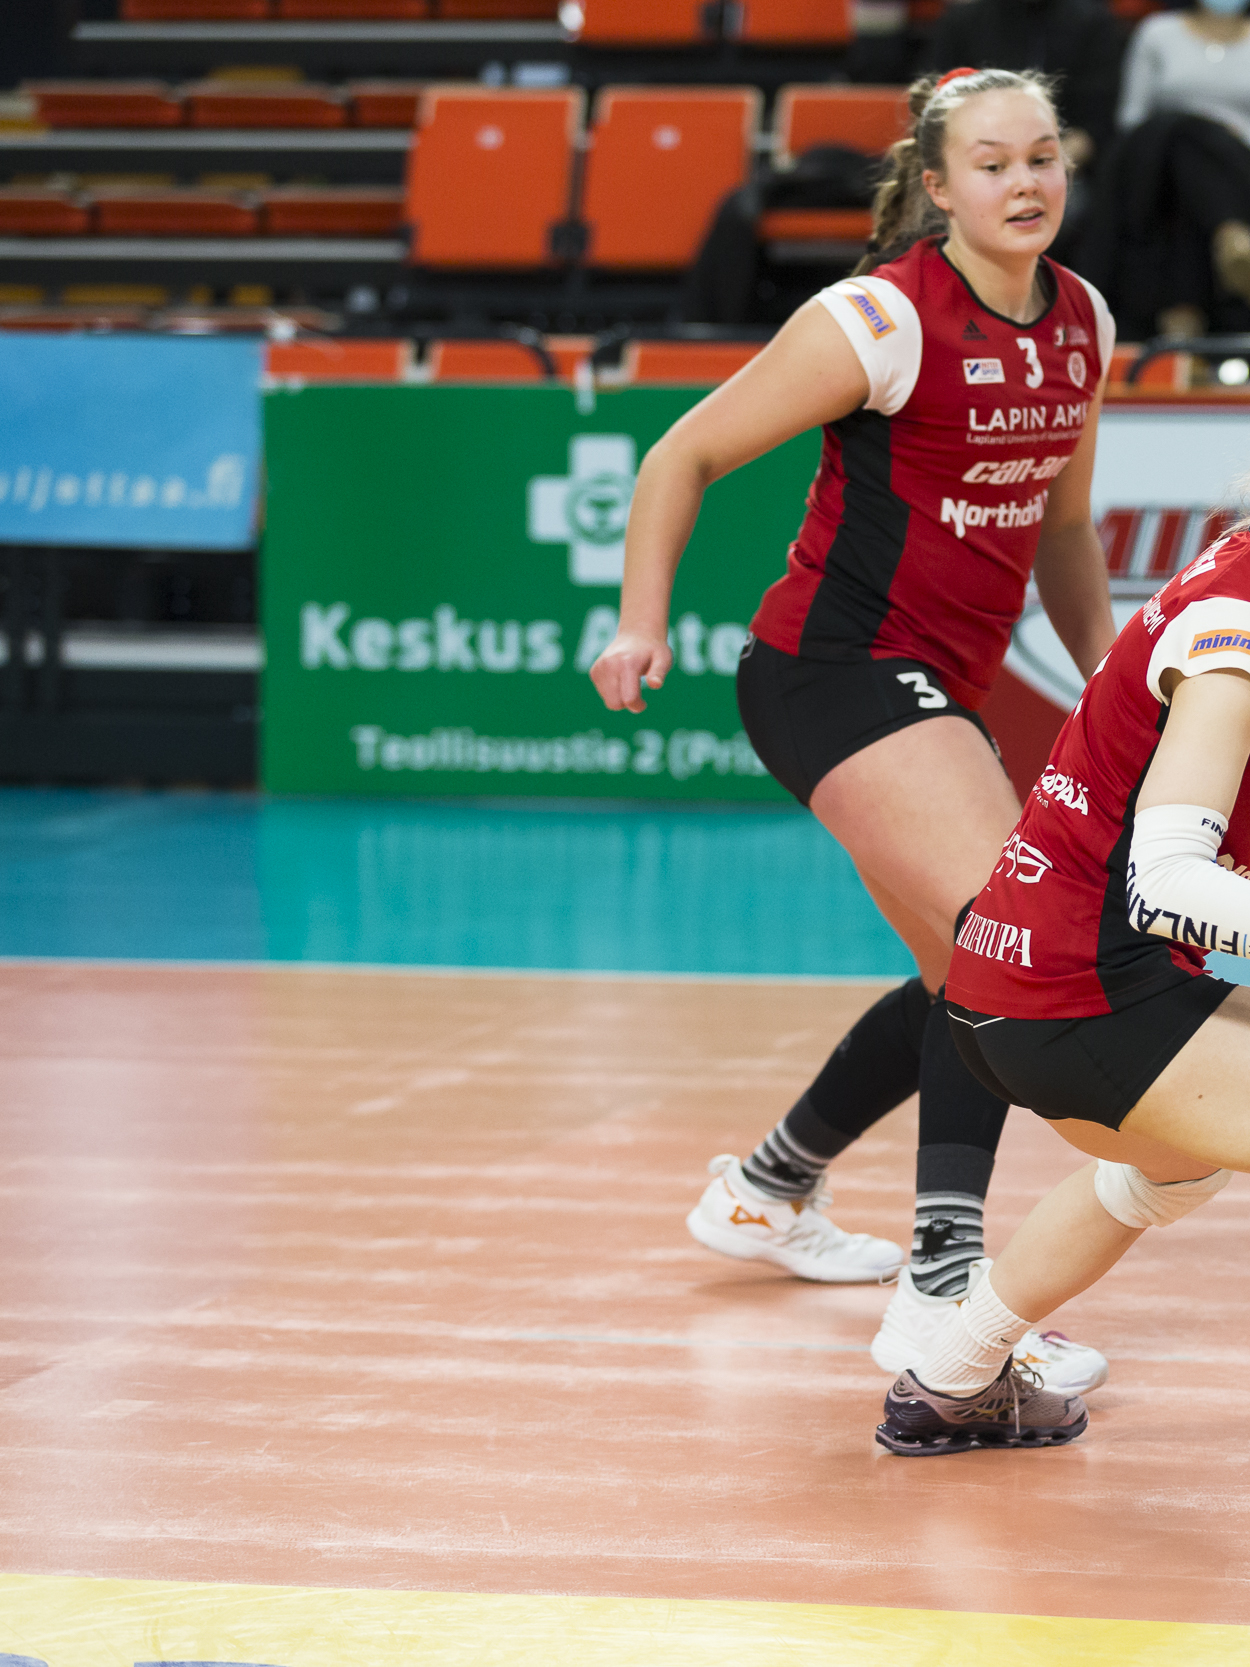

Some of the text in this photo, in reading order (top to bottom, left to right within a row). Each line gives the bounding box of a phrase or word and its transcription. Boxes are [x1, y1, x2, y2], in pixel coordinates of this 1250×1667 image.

[1015, 337, 1044, 389] 3
[968, 405, 1047, 431] LAPIN
[302, 602, 563, 675] Keskus
[896, 671, 948, 709] 3
[632, 729, 664, 775] 2
